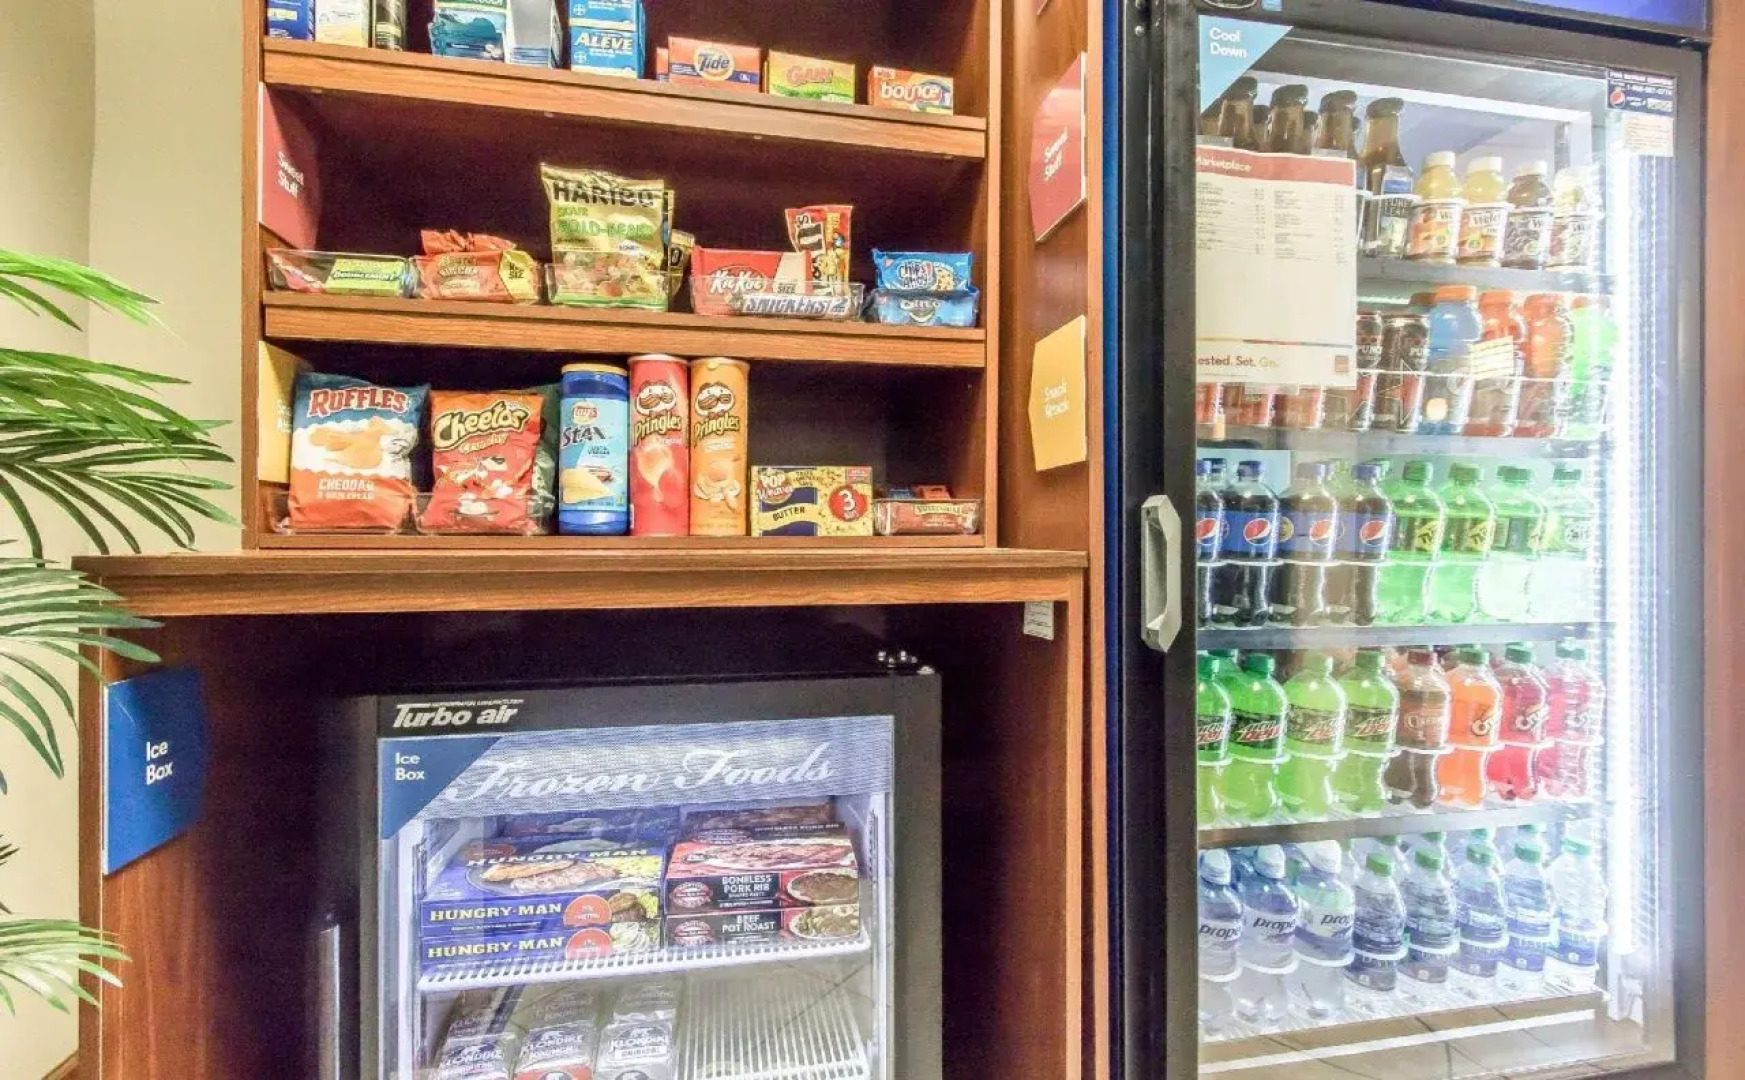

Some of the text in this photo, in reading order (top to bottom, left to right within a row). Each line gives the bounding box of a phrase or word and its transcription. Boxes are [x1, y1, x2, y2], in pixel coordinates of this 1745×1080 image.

[574, 32, 633, 50] ALEVE
[1209, 27, 1240, 43] Cool
[1210, 41, 1247, 58] Down
[697, 51, 731, 72] Tide
[880, 83, 942, 102] bounce
[553, 180, 655, 208] HARIBO
[777, 283, 796, 294] SIZE
[744, 295, 828, 315] SNICKERS
[1198, 354, 1233, 367] ested.
[1236, 355, 1257, 368] Set.
[307, 386, 408, 417] RUFFLES
[433, 400, 530, 452] Cheetos
[634, 414, 683, 447] Pringles
[694, 415, 741, 447] Pringles
[318, 479, 374, 491] CHEDDAR
[761, 474, 785, 488] POP
[839, 490, 857, 511] 3
[772, 505, 806, 521] BUTTER
[392, 702, 519, 728] Turbo air
[146, 739, 168, 762] Ice
[395, 752, 421, 765] Ice
[146, 763, 173, 786] Box
[395, 767, 425, 781] Box
[445, 741, 835, 801] Frozen Foods
[722, 875, 772, 885] BONELESS
[723, 882, 770, 893] PORK RIB
[430, 903, 563, 921] HUNGRY-MAN
[736, 914, 760, 924] BEEF
[1320, 914, 1352, 926] prop
[722, 921, 775, 933] POT ROAST
[1199, 924, 1241, 940] prope
[1253, 916, 1295, 932] prope
[427, 937, 564, 958] HUNGRY-MAN
[611, 1034, 670, 1050] KLONDIKE
